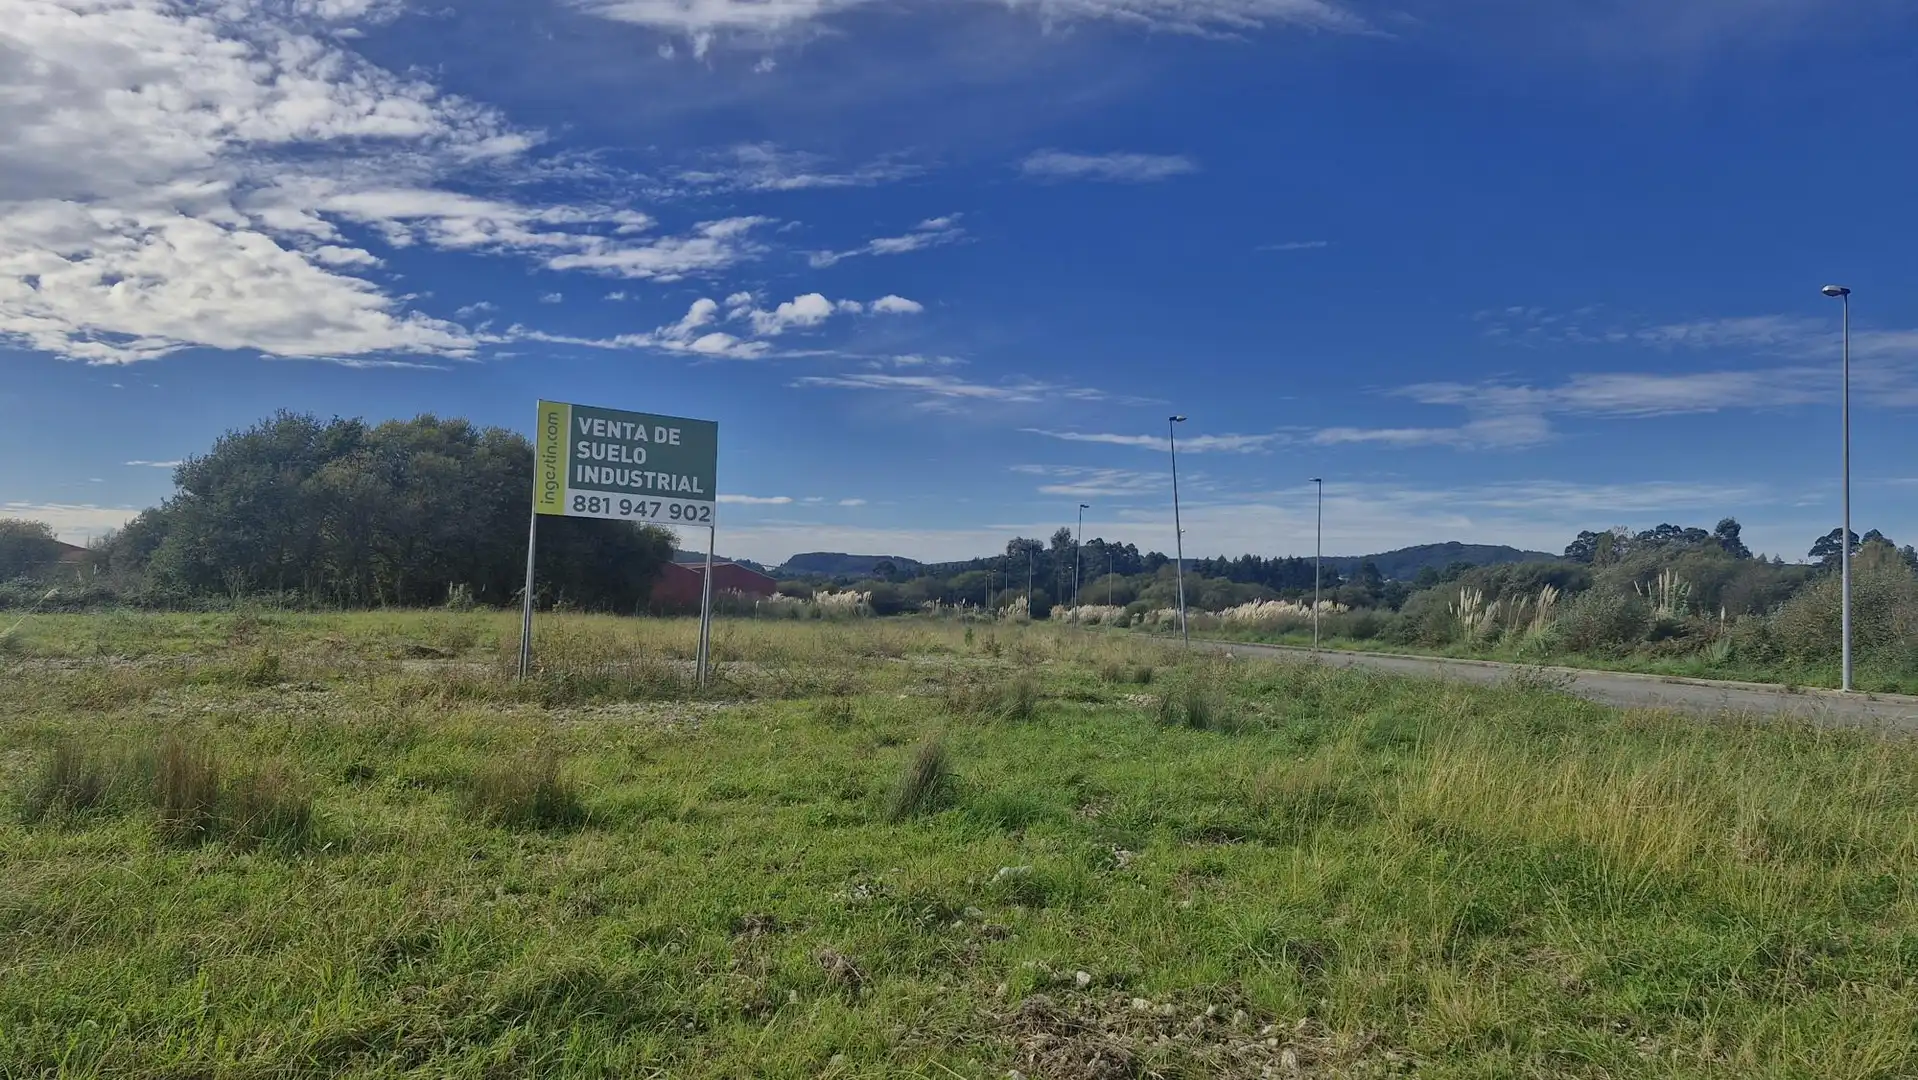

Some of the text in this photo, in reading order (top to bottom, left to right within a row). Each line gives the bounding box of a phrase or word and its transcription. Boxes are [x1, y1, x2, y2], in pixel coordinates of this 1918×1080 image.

[578, 417, 681, 445] VENTA DE
[540, 412, 559, 504] ingestin.com
[577, 441, 647, 464] SUELO
[577, 465, 704, 493] INDUSTRIAL
[573, 495, 711, 522] 881 947 902
